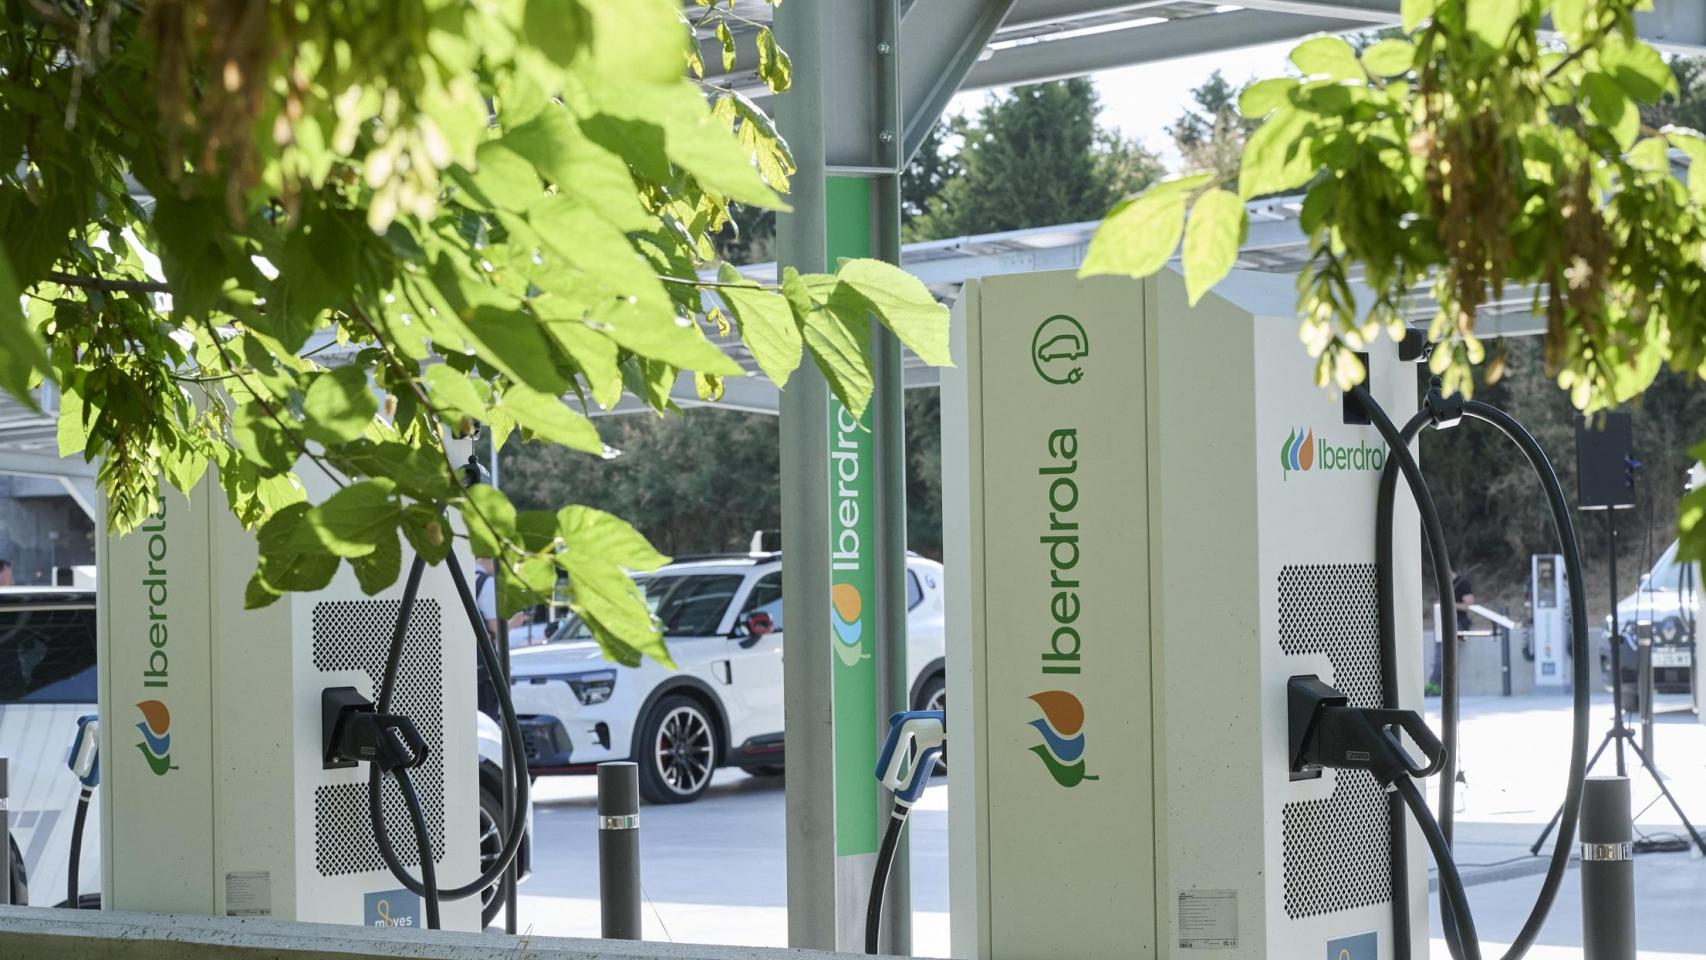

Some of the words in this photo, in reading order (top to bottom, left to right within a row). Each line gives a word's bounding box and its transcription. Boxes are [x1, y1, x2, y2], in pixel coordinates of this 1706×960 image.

[831, 393, 860, 570] Iberdro
[1318, 438, 1386, 471] Iberdrol
[1038, 428, 1081, 674] Iberdrola
